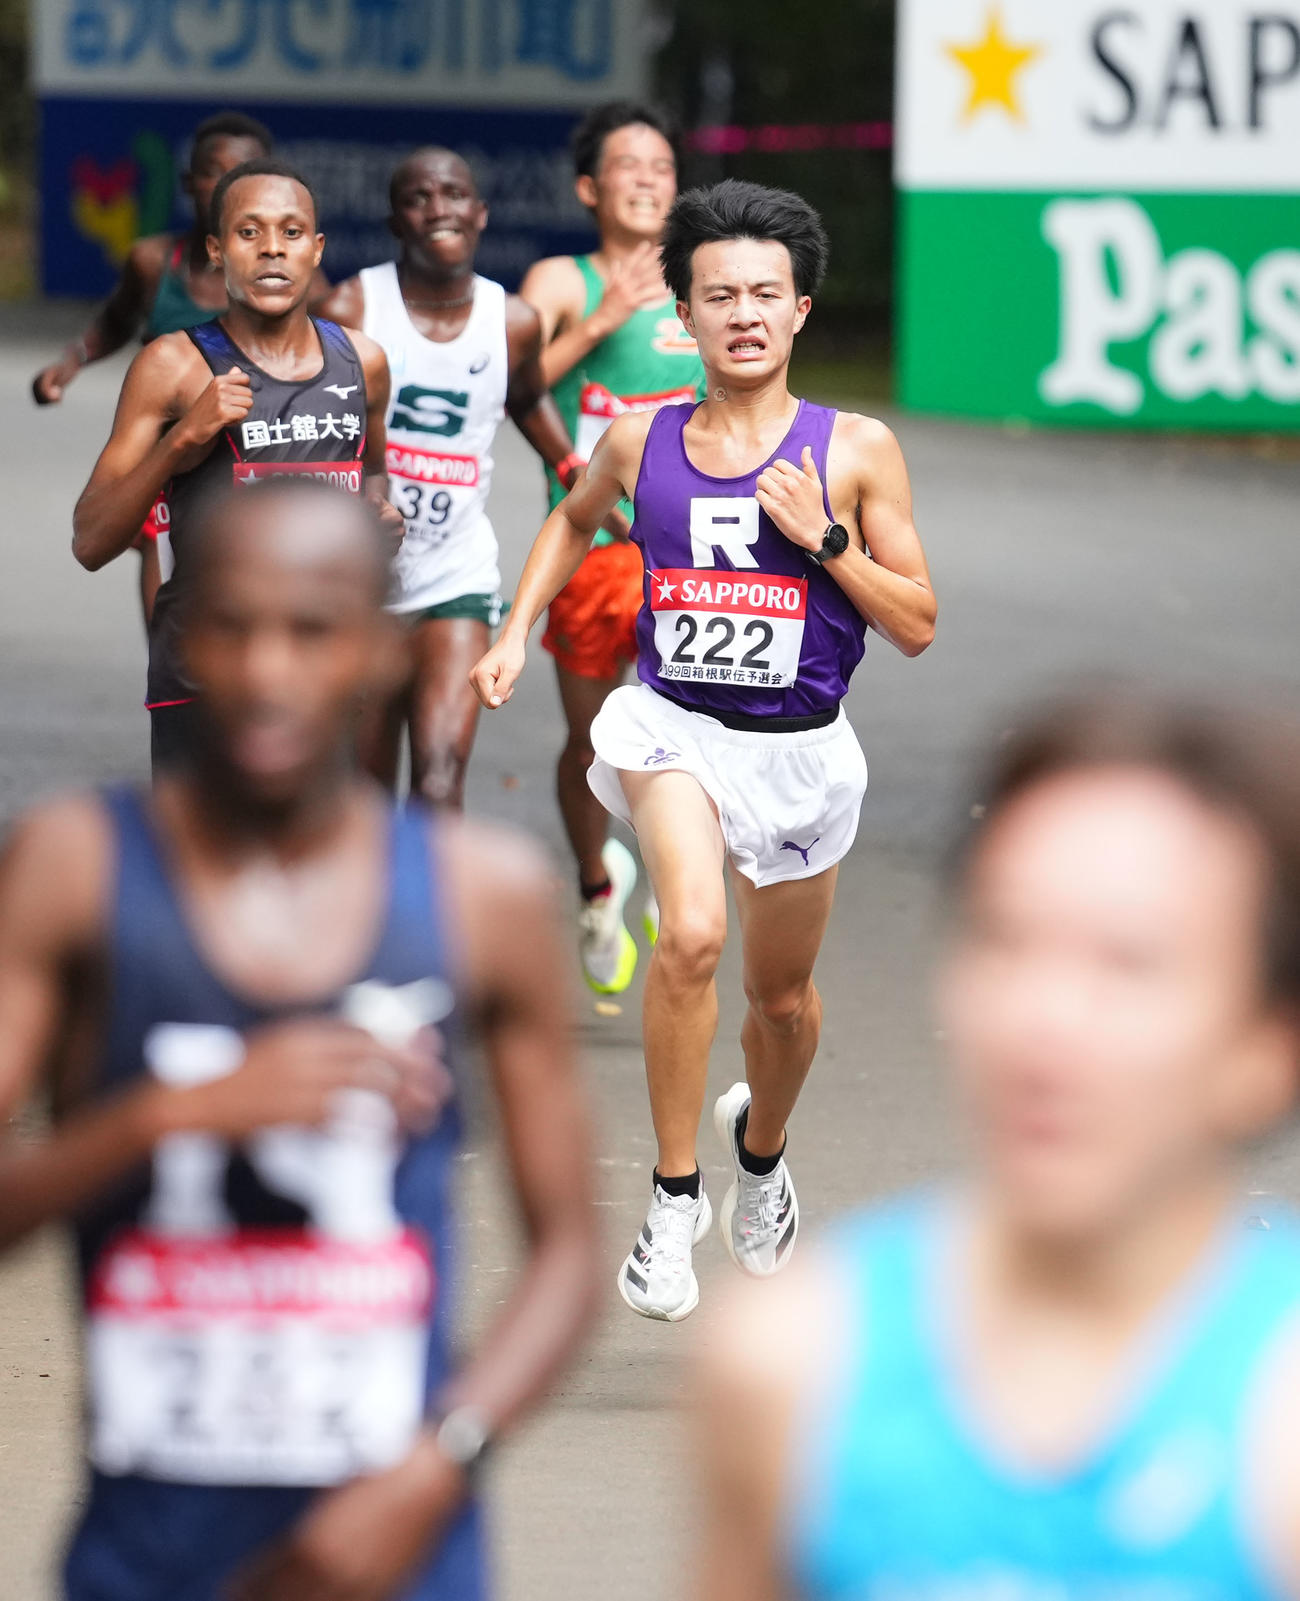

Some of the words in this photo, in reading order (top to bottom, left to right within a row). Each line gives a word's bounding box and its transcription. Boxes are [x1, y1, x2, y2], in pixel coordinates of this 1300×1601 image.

[1085, 8, 1300, 134] SAP
[1036, 196, 1300, 416] Pas
[241, 412, 361, 450] 国士舘大学
[390, 383, 468, 437] S
[387, 448, 476, 484] SAPPORO
[690, 496, 760, 568] R
[680, 578, 801, 611] SAPPORO
[671, 613, 775, 670] 222
[657, 664, 783, 685] 99回箱根駅伝予選会
